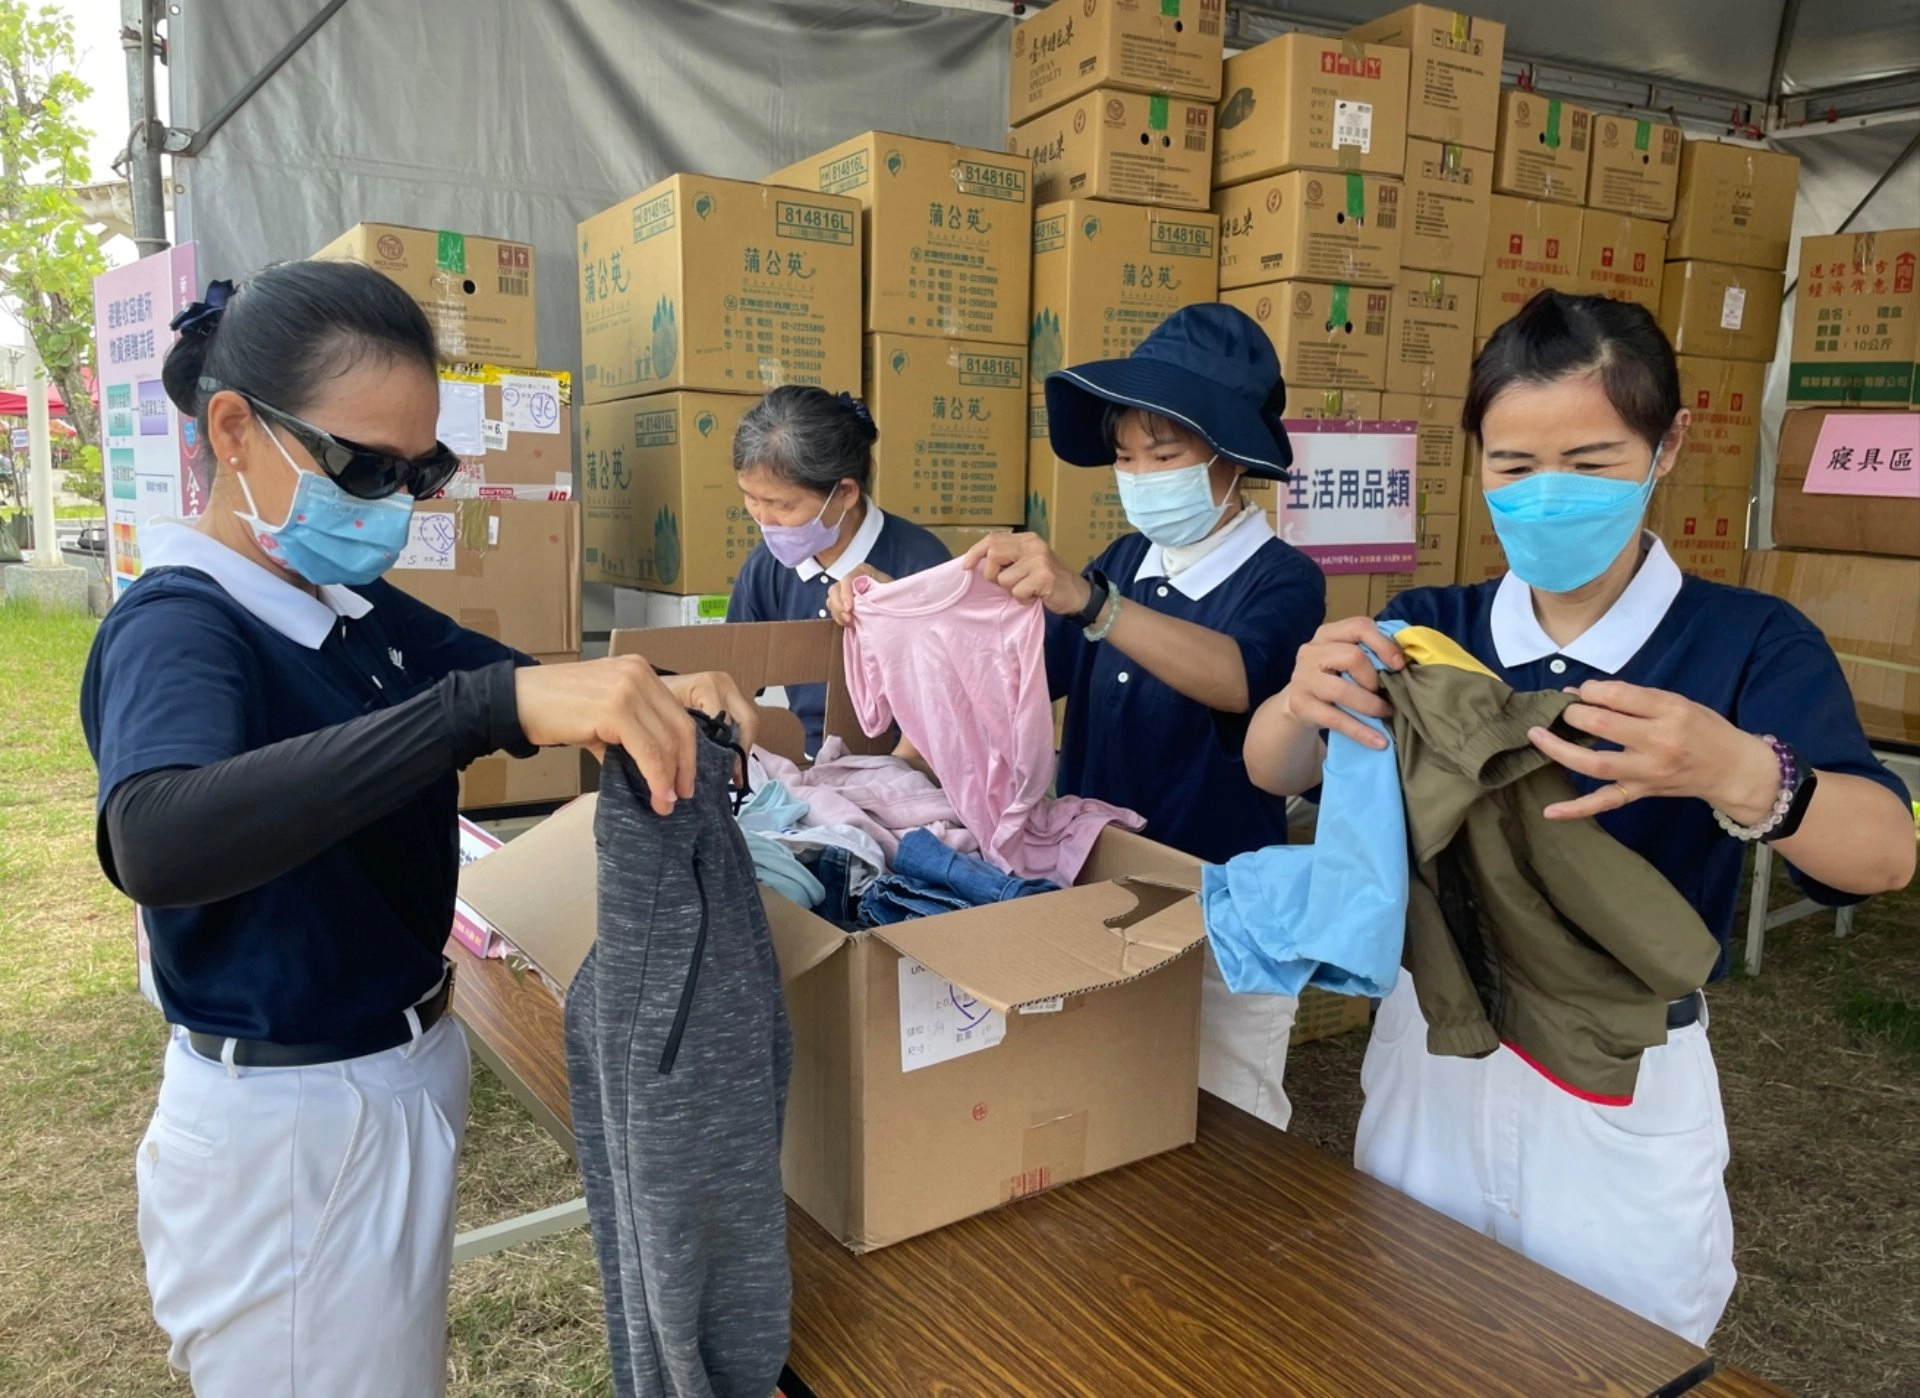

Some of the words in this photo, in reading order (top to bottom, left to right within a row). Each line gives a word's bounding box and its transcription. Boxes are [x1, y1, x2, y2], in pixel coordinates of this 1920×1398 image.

[966, 166, 1021, 188] 814816L
[785, 207, 849, 230] 814816L
[929, 202, 992, 234] 蒲公英
[1157, 225, 1210, 244] 814816L
[744, 247, 816, 279] 蒲公英
[585, 251, 630, 304] 蒲公英
[1122, 263, 1182, 290] 蒲公英
[966, 357, 1019, 375] 814816L
[932, 396, 992, 422] 蒲公英
[586, 447, 632, 490] 蒲公英
[1826, 446, 1914, 472] 寢具區
[1286, 468, 1410, 510] 生活用品類
